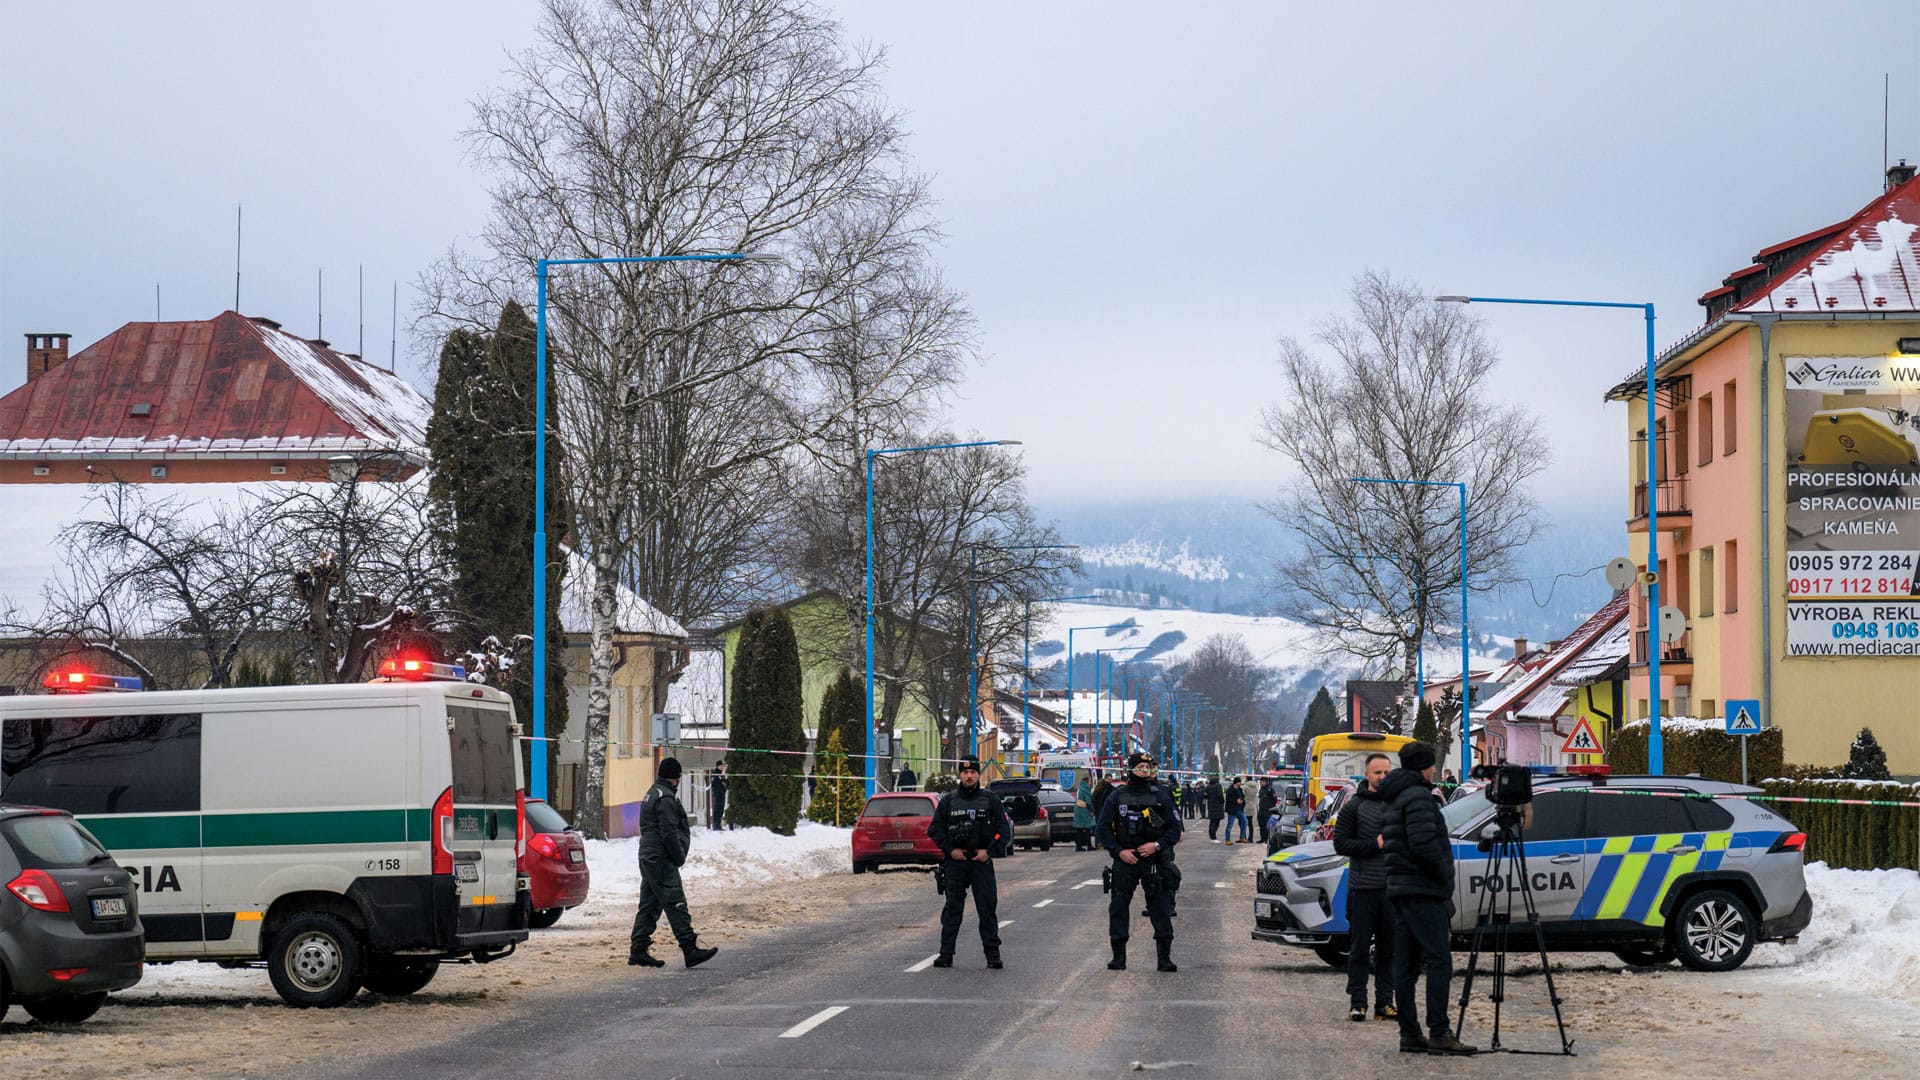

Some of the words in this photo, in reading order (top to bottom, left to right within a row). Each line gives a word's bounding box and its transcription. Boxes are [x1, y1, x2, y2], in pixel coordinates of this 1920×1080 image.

[1814, 364, 1884, 387] Galica
[1799, 496, 1920, 511] SPRACOVANIE
[1824, 518, 1899, 535] KAMEŇA
[1789, 555, 1834, 571] 0905
[1839, 555, 1873, 571] 972
[1878, 555, 1912, 570] 284
[1788, 578, 1834, 593] 0917
[1840, 578, 1872, 593] 112
[1877, 578, 1911, 593] 814
[1789, 604, 1863, 620] VÝROBA
[1873, 607, 1920, 620] REKL
[1831, 622, 1878, 639] 0948
[1884, 622, 1919, 639] 106
[377, 859, 400, 871] 158
